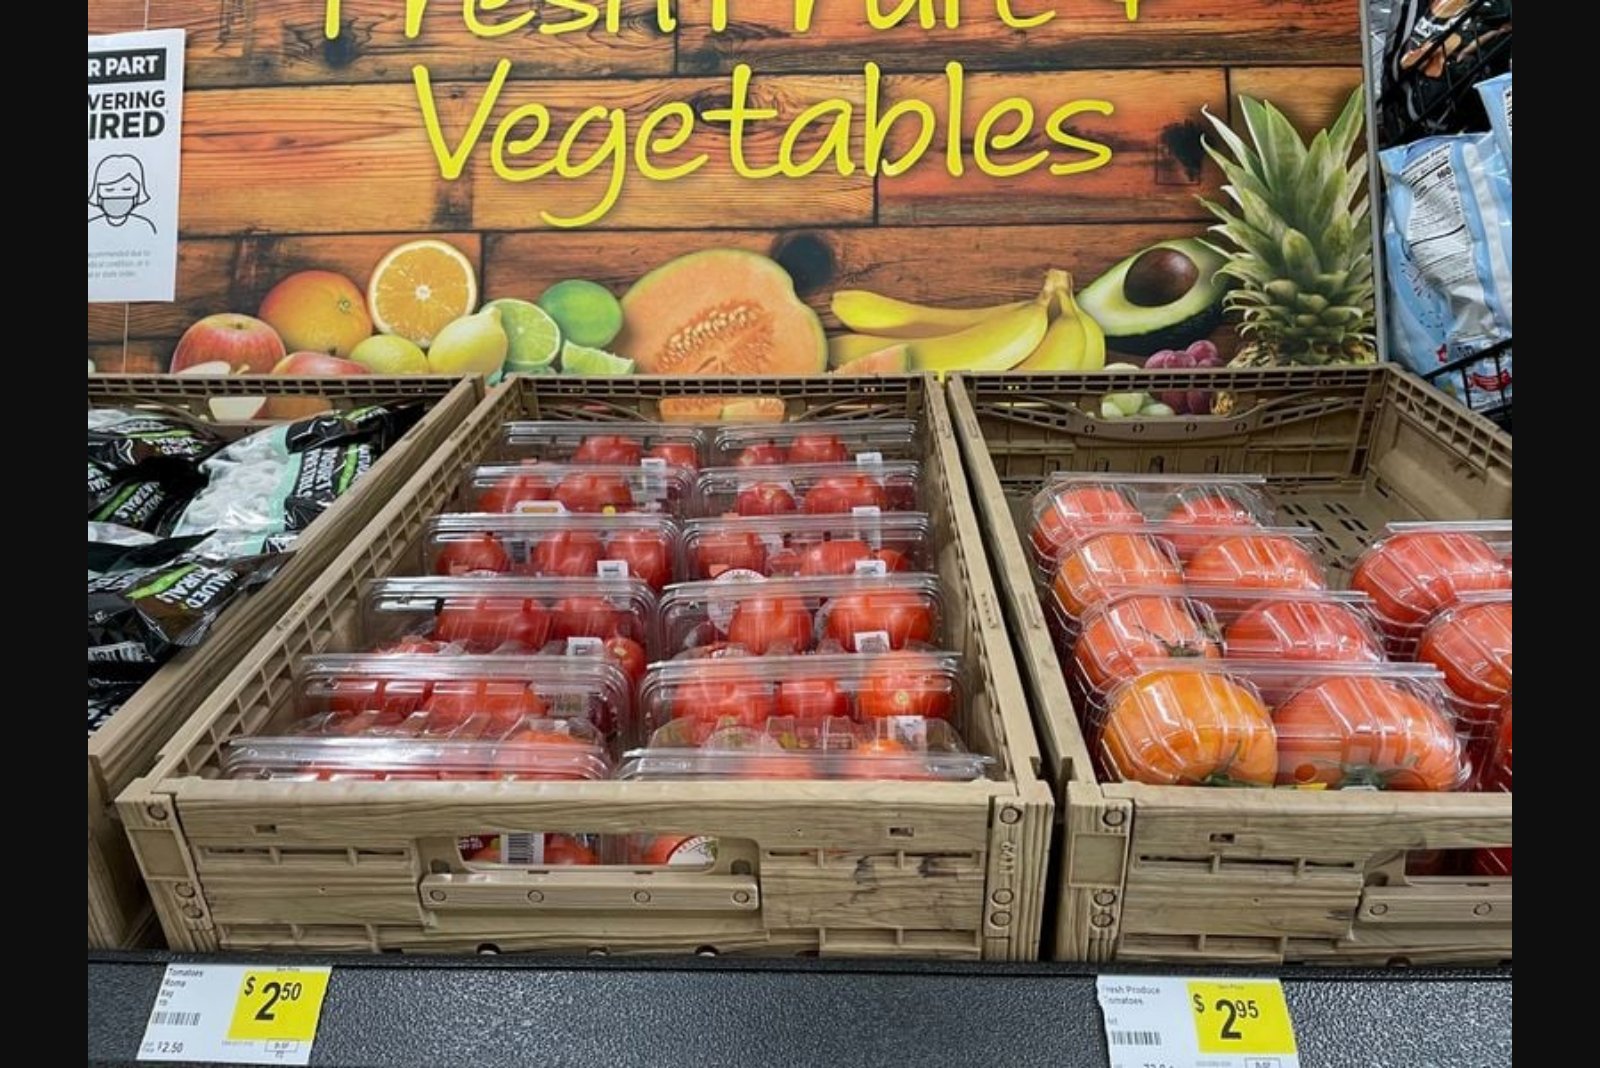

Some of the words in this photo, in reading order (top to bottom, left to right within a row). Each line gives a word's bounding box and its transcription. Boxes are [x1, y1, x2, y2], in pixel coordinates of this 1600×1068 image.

[105, 55, 160, 76] PART
[88, 90, 166, 111] VERING
[89, 111, 166, 140] IRED
[414, 61, 1113, 226] Vegetables
[244, 975, 256, 997] $
[1192, 992, 1205, 1014] $
